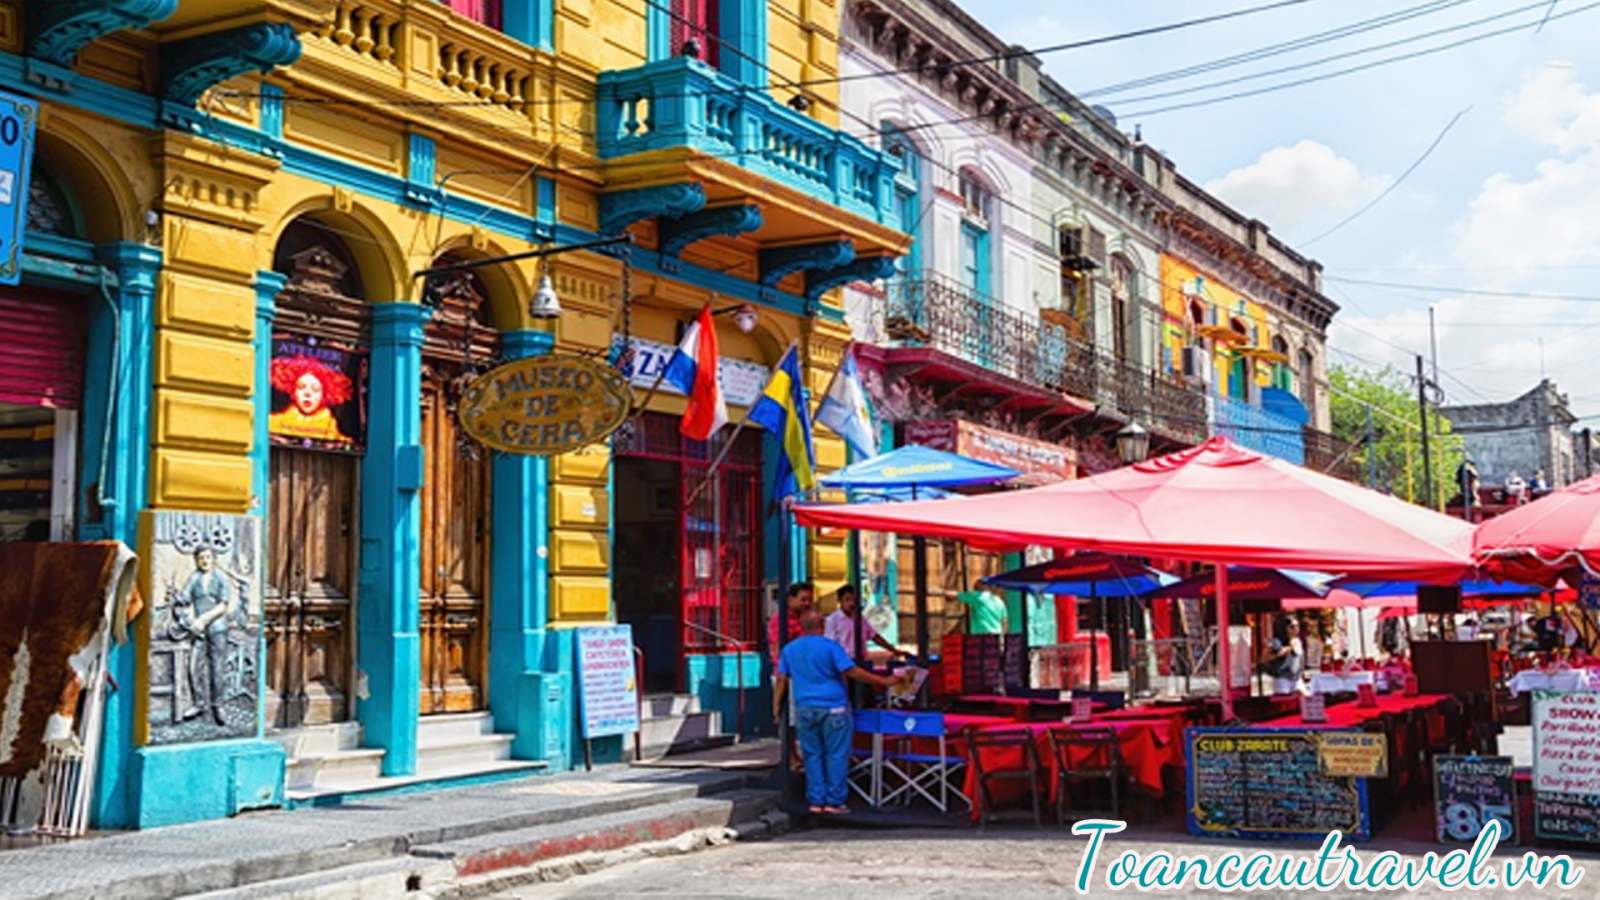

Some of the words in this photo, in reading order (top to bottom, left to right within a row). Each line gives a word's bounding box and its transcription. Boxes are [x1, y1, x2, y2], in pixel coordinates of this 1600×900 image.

[493, 366, 593, 400] MUSEO
[525, 395, 560, 417] DE
[501, 418, 586, 446] CERA
[1200, 739, 1233, 752] CLUB
